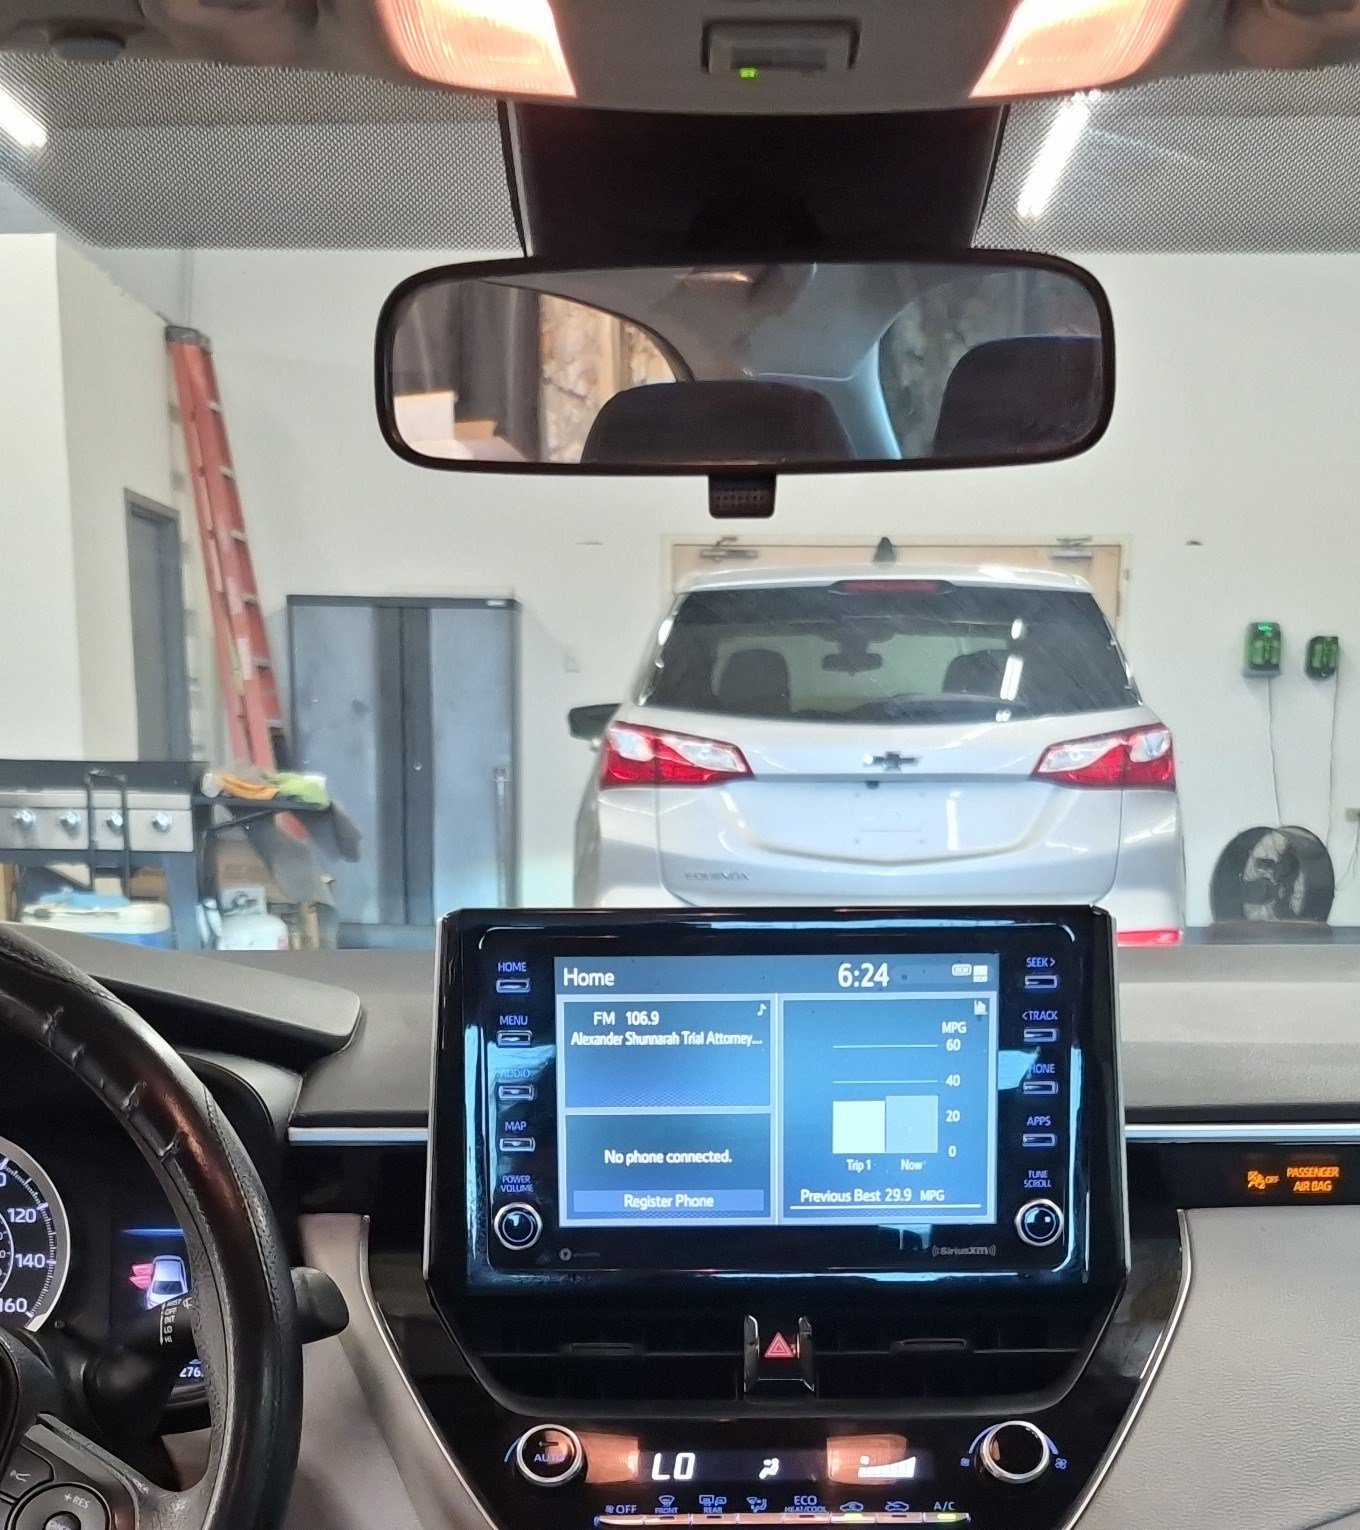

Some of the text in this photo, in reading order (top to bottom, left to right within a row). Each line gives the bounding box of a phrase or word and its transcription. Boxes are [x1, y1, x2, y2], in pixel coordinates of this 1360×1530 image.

[498, 961, 527, 973] HOME
[563, 967, 615, 987] Home
[838, 962, 890, 988] 6:24
[499, 1015, 528, 1026] MENU
[593, 1010, 660, 1026] FM 106.9
[941, 1021, 967, 1034] MPG
[571, 1031, 623, 1046] Alexander
[625, 1031, 679, 1046] Shunnarah
[681, 1030, 704, 1045] Trial
[946, 1039, 961, 1051] 60
[500, 1068, 531, 1078] AUDIO
[1027, 1063, 1056, 1074] HONE
[945, 1074, 961, 1086] 40
[945, 1110, 961, 1122] 20
[1026, 1116, 1051, 1126] APPS
[505, 1121, 527, 1131] MAP
[948, 1145, 956, 1157] 0
[604, 1149, 733, 1167] No phone connected.
[846, 1159, 872, 1173] Trip 1
[900, 1159, 923, 1171] Now
[1028, 1169, 1048, 1179] TUNE
[1286, 1166, 1340, 1178] PASSENGER
[502, 1174, 531, 1184] POWER
[1024, 1179, 1051, 1188] SCROLL
[500, 1183, 534, 1193] VOLUME
[1293, 1180, 1332, 1191] AIR BAG
[623, 1193, 714, 1210] Register Phone
[800, 1188, 945, 1203] Previous Best 29.9 MPG
[7, 1208, 37, 1223] 120
[15, 1253, 45, 1268] 140
[651, 1452, 696, 1481] LO
[793, 1495, 818, 1506] ECO
[933, 1500, 955, 1511] A/C
[615, 1504, 637, 1514] OFF
